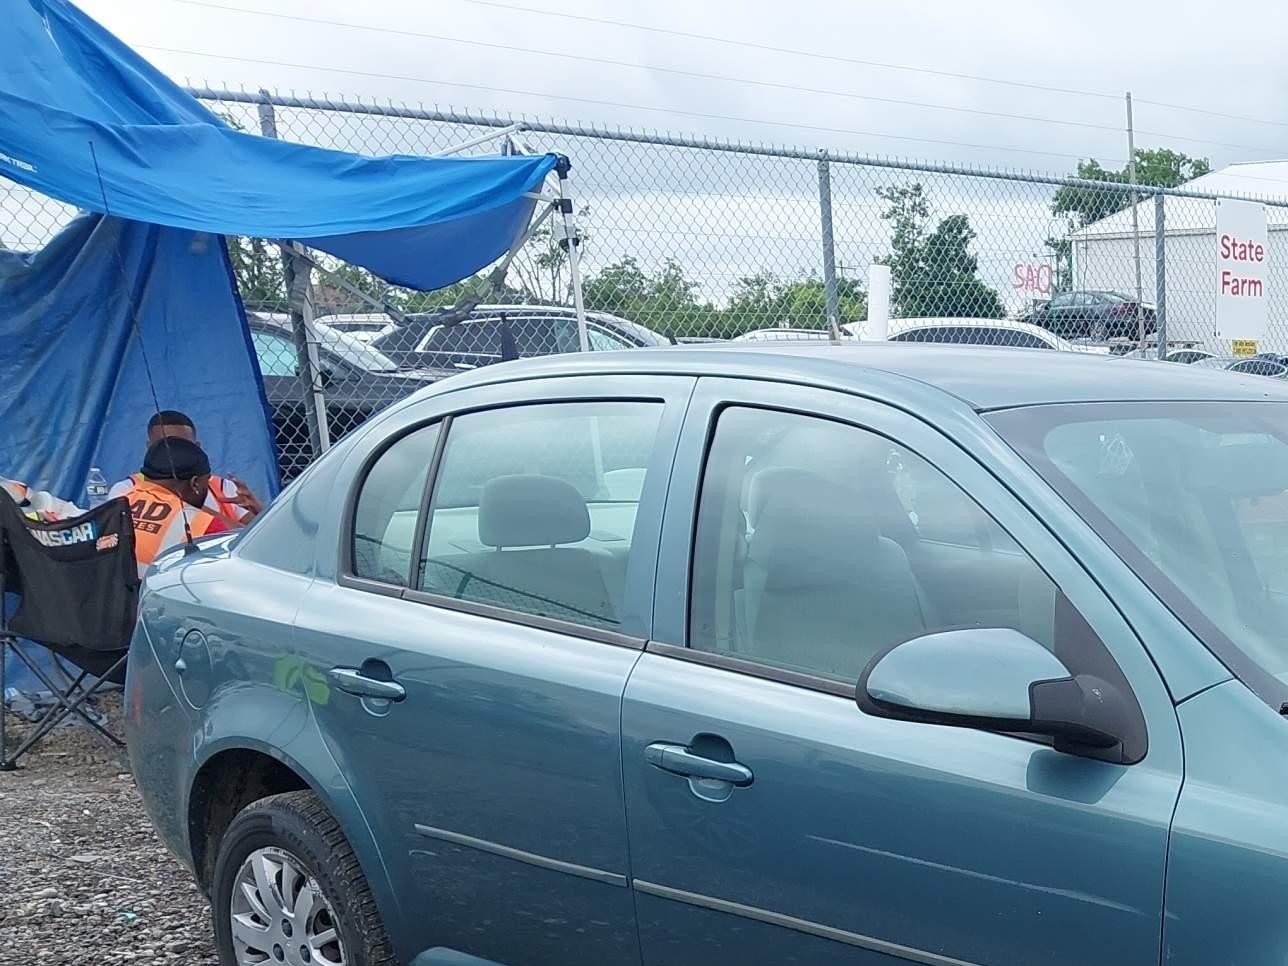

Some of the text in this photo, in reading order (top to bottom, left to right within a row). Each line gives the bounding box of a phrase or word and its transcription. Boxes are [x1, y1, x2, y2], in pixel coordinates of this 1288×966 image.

[1220, 234, 1264, 262] State
[1221, 271, 1262, 297] Farm
[26, 522, 94, 547] NASCAR
